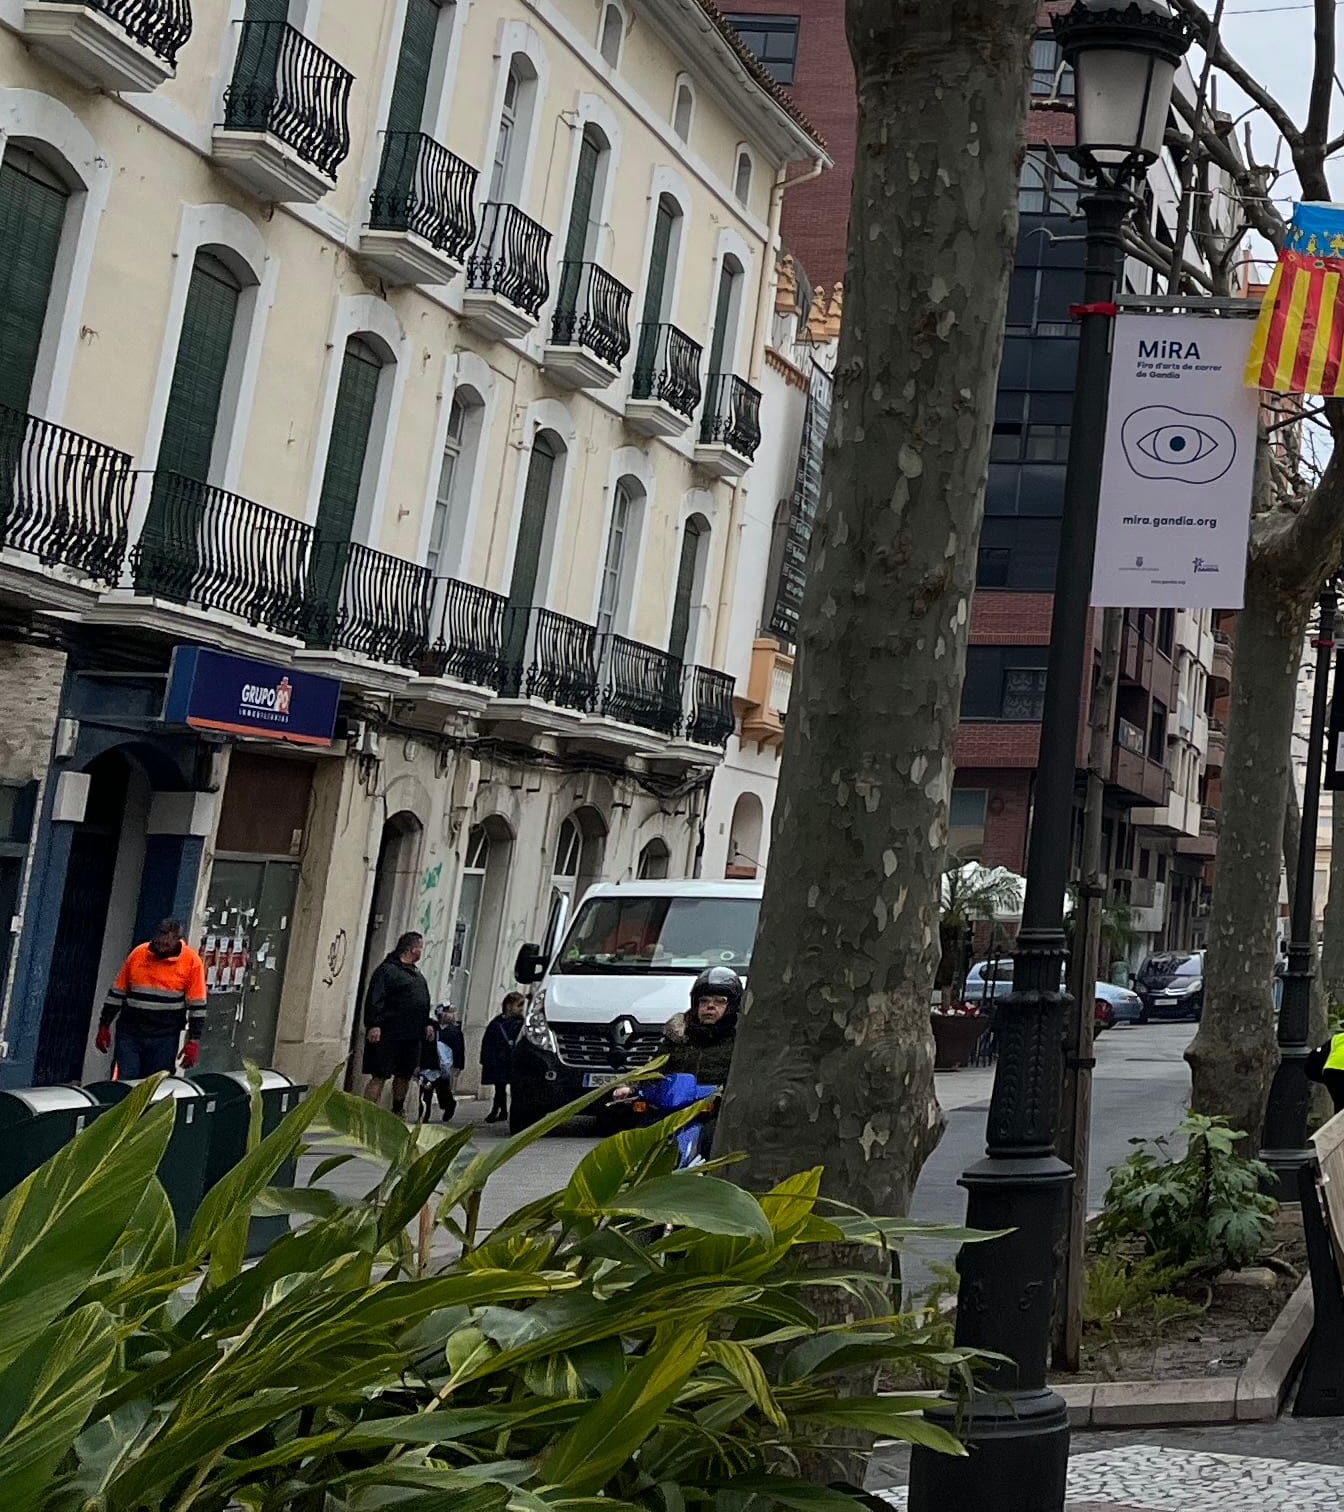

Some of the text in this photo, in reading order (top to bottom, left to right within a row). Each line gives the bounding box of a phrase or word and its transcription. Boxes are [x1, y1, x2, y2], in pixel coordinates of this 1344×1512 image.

[1138, 340, 1200, 359] MiRA
[1149, 371, 1181, 379] Gandia
[1122, 514, 1217, 529] mira.gandia.org
[241, 683, 276, 707] GRUPO
